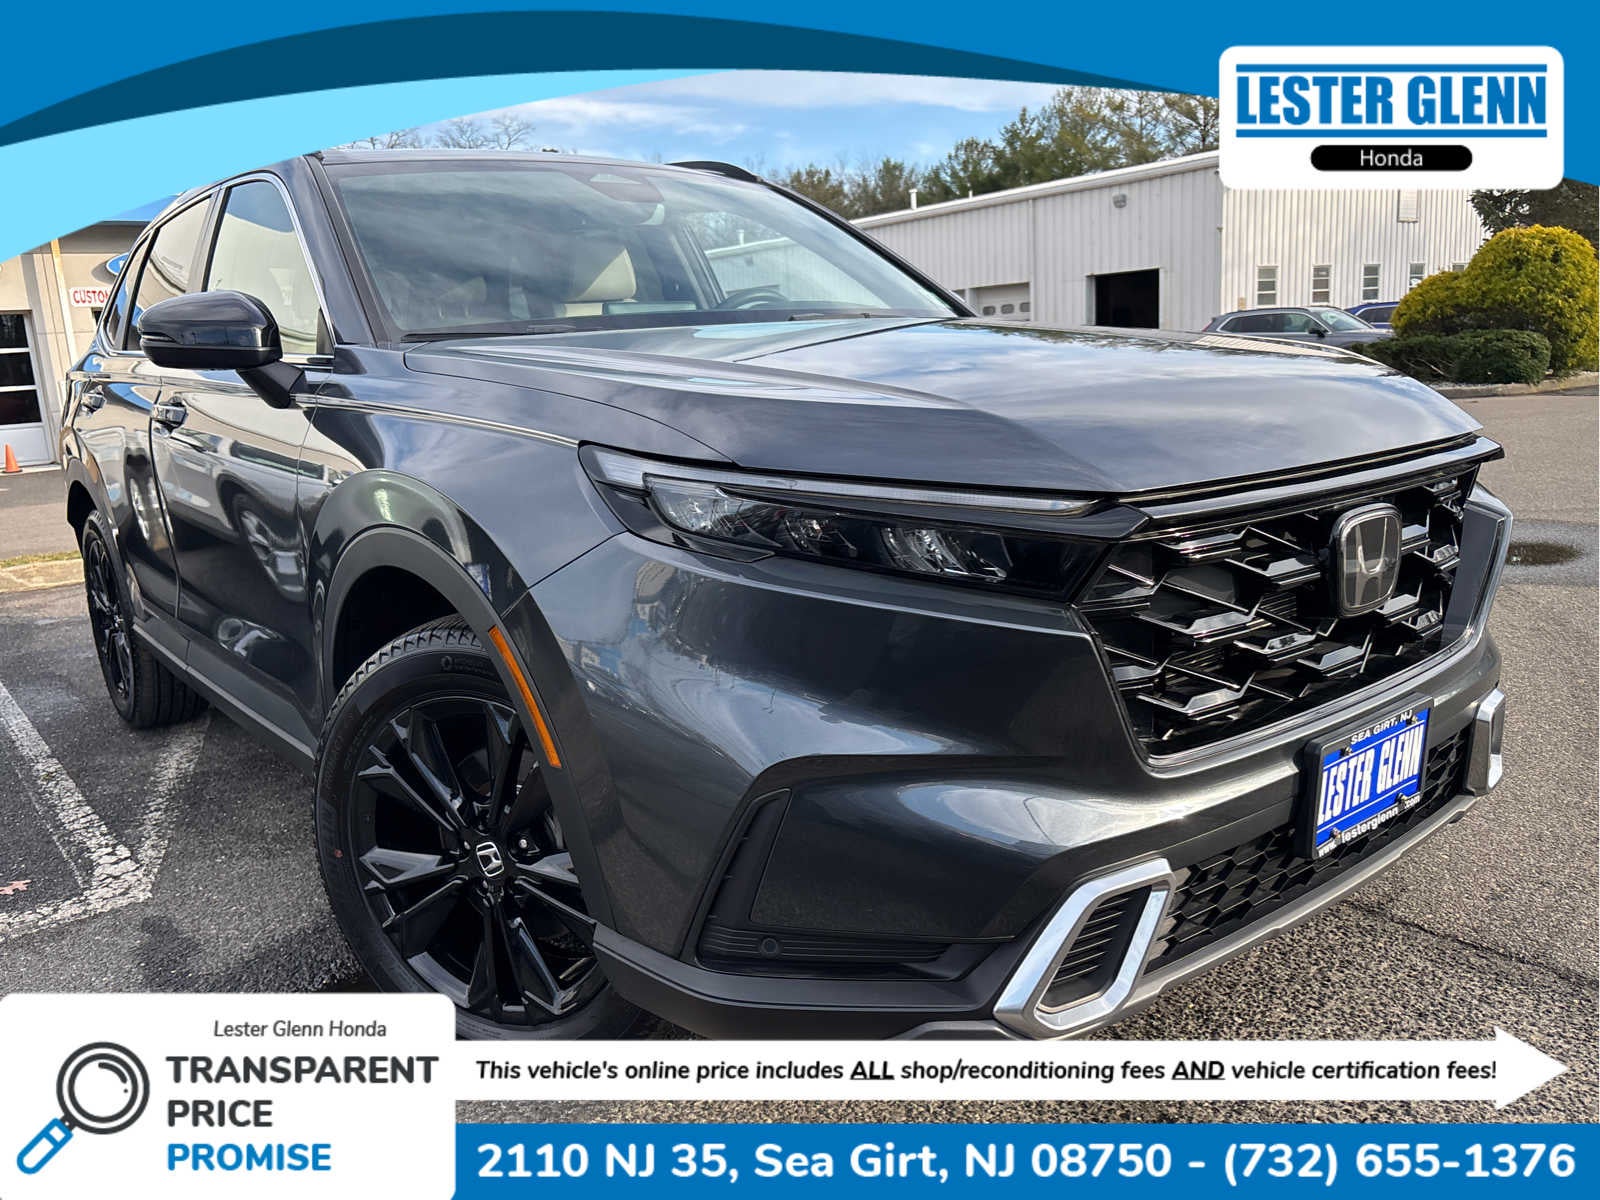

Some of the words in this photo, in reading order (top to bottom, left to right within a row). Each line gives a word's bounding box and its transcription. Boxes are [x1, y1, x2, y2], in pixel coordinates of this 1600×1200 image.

[1351, 731, 1371, 745] SEA
[1373, 717, 1398, 735] GIRT,
[1400, 710, 1413, 722] NJ
[1317, 749, 1375, 826] LESTER
[1376, 724, 1425, 794] GLENN
